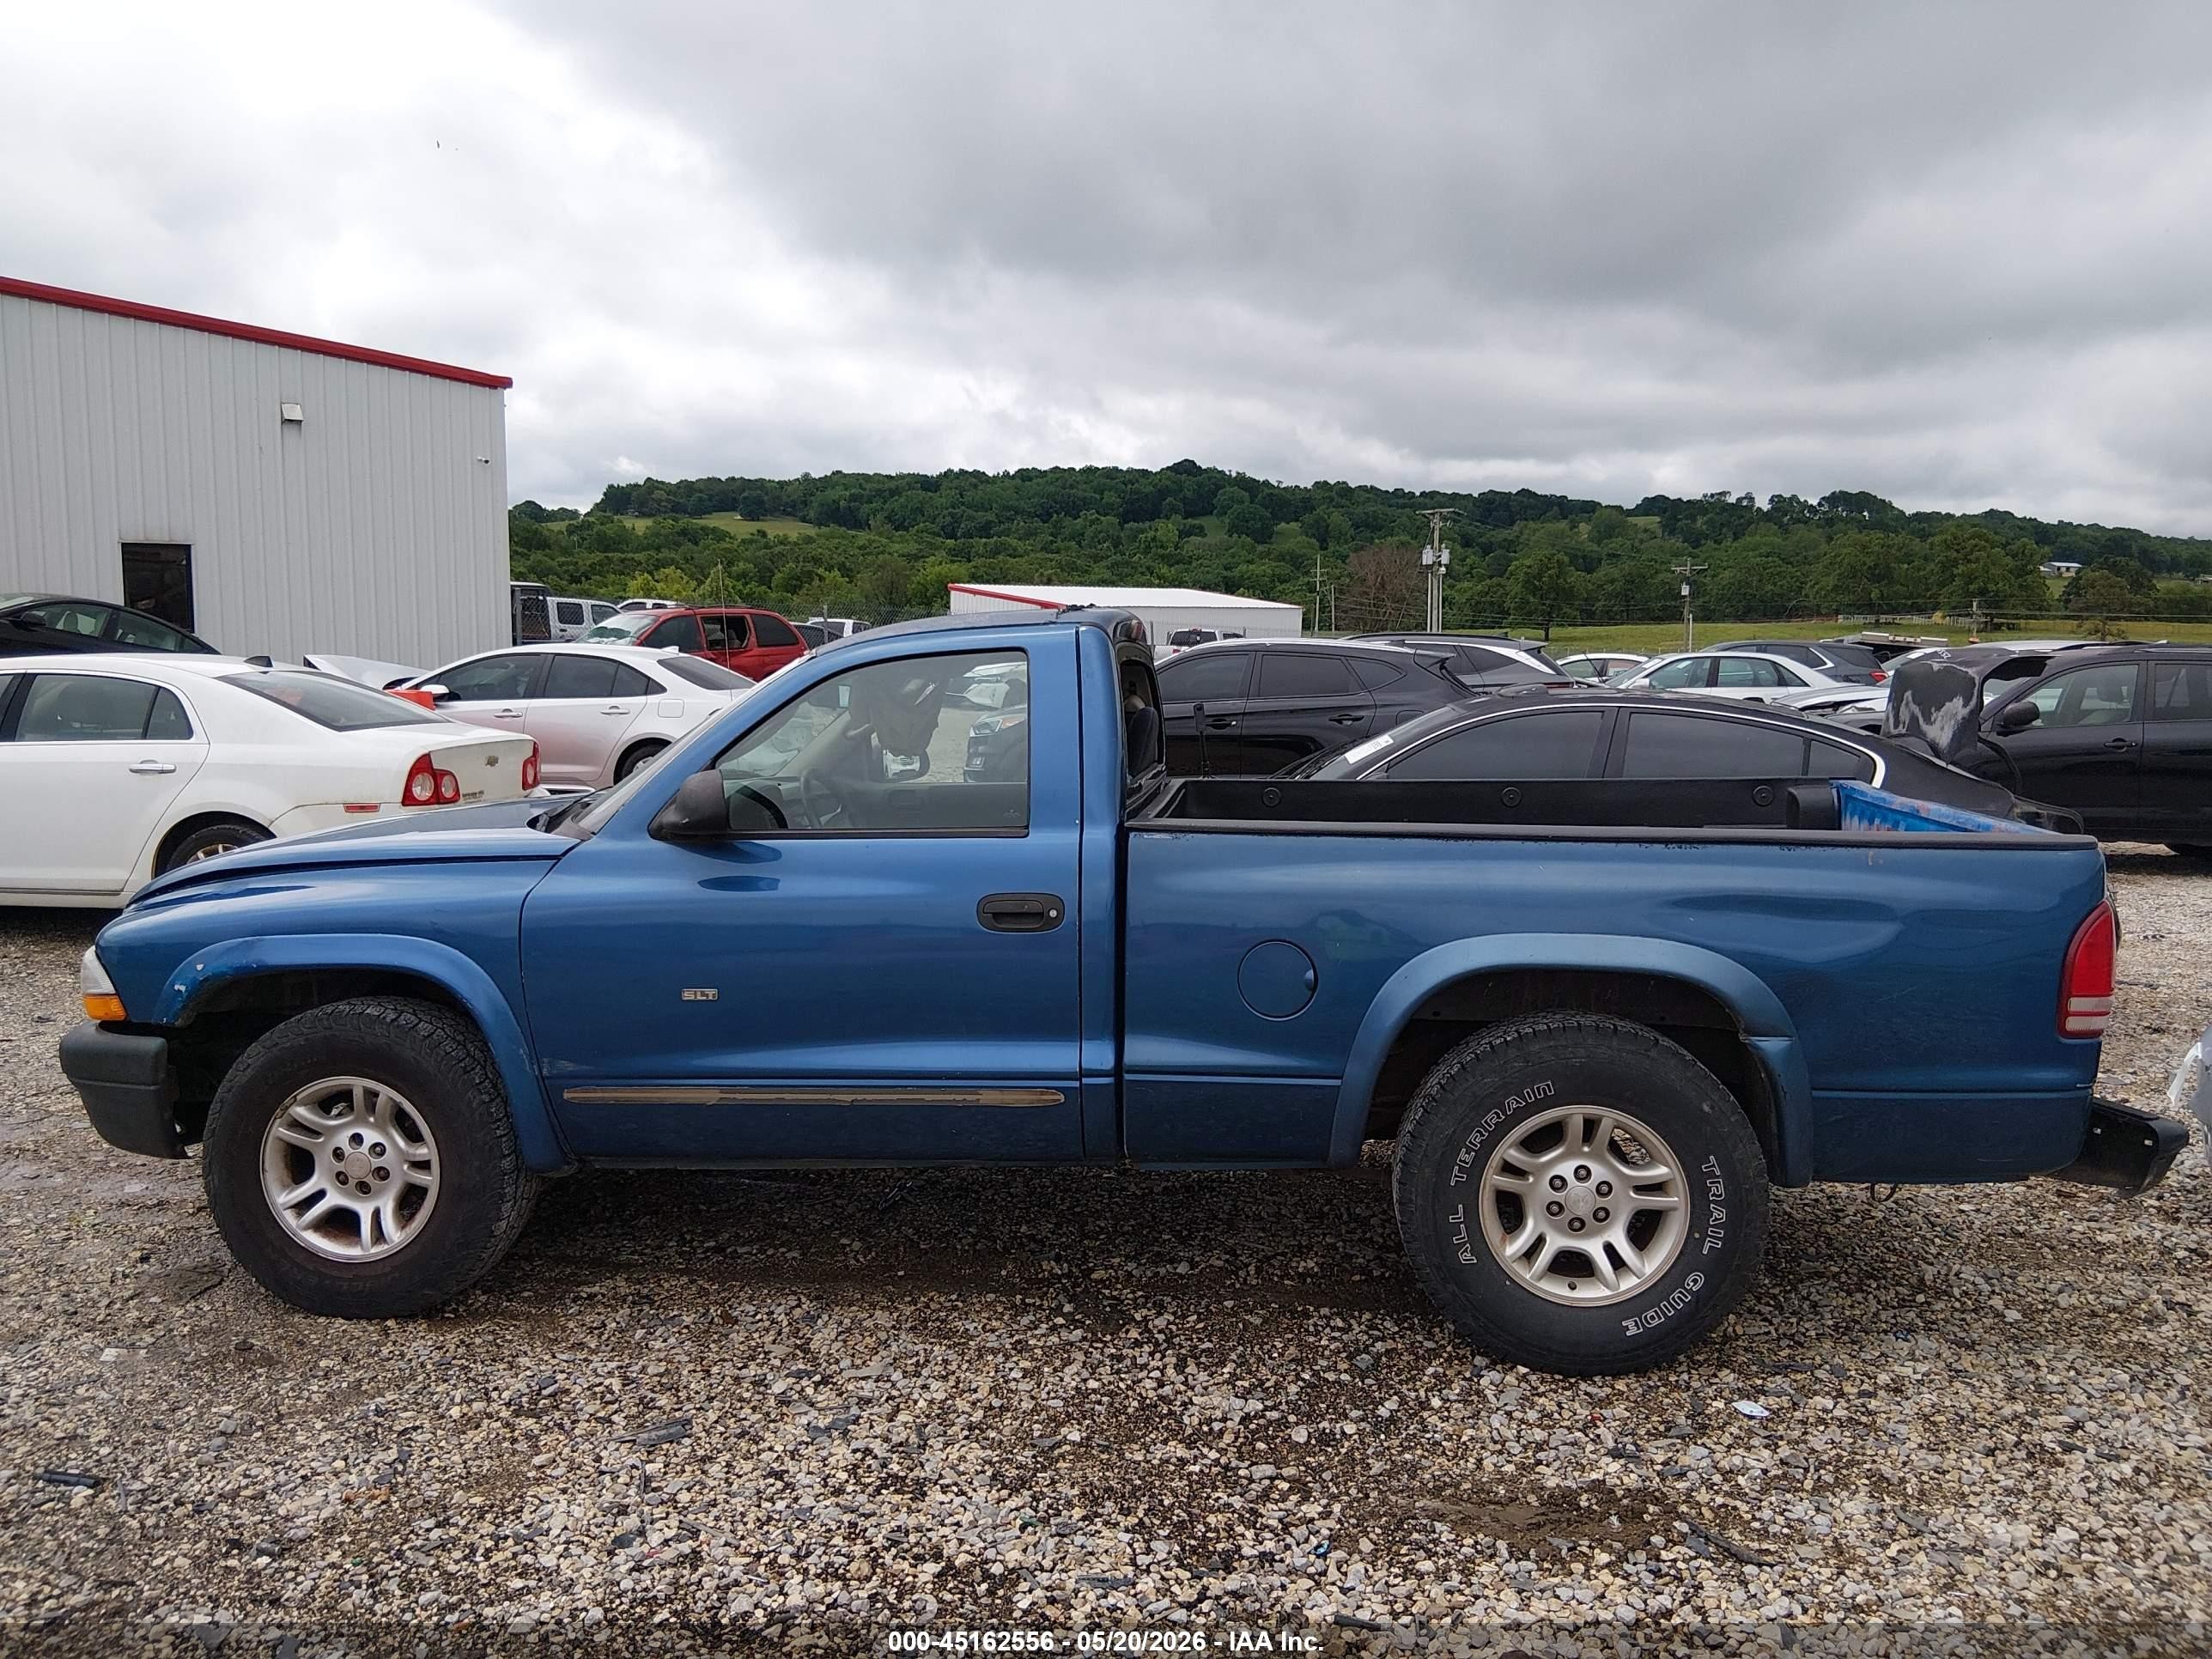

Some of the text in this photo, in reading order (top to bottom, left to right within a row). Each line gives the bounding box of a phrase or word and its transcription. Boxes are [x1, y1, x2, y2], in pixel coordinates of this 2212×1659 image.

[683, 990, 716, 1000] SLT
[1449, 1081, 1555, 1265] ALL TERRAIN
[1621, 1155, 1727, 1336] TRAIL GUIDE
